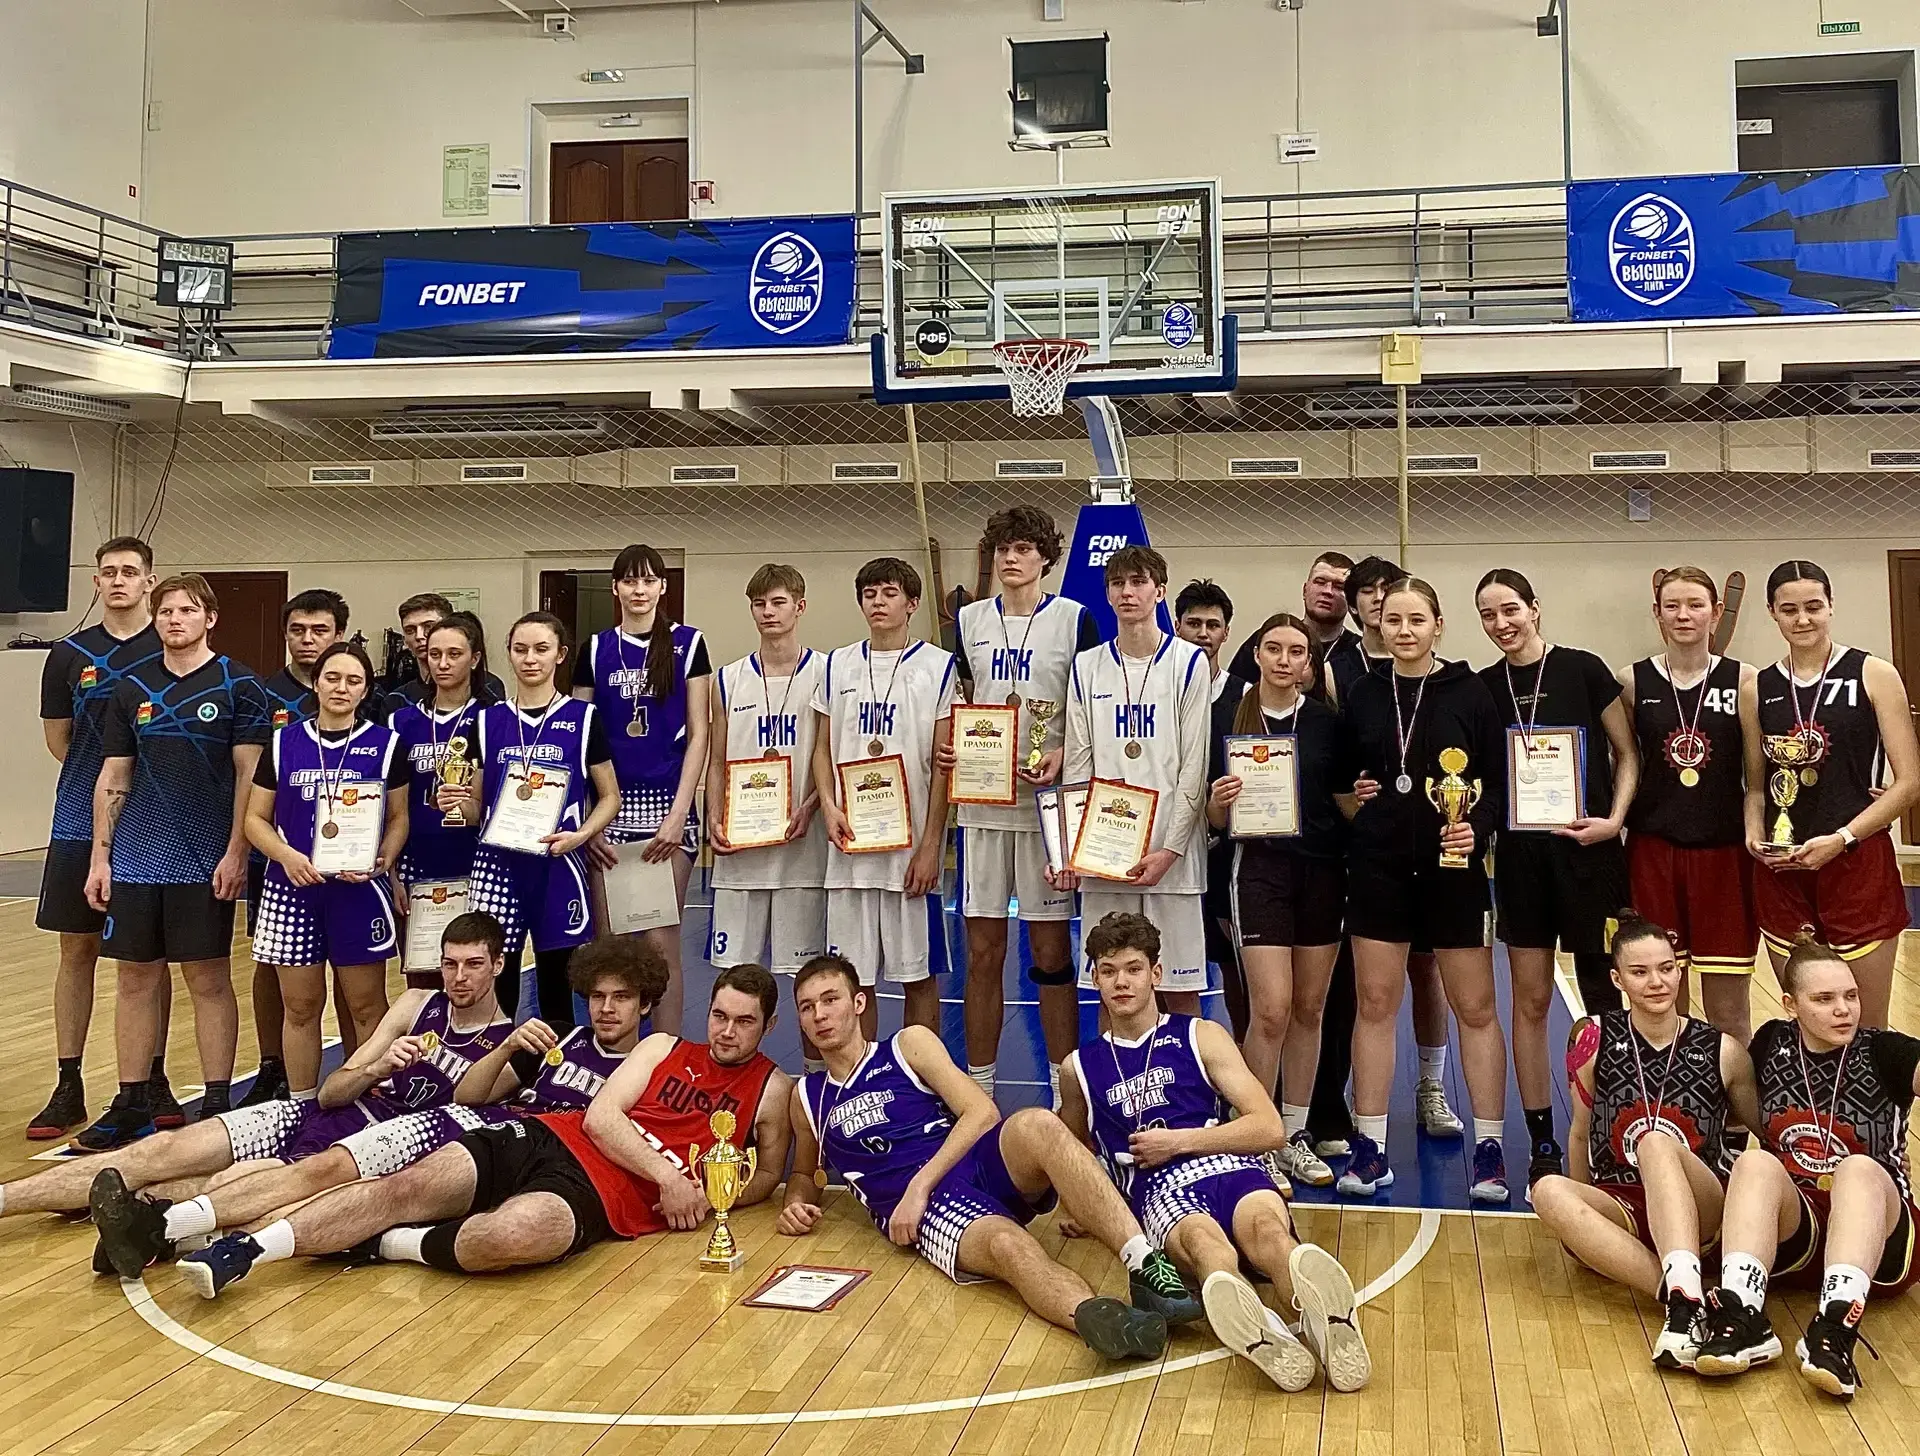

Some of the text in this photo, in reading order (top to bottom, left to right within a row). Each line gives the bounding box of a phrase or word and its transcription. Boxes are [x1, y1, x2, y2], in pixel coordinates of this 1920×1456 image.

[1823, 23, 1858, 33] ВЫХОД
[1157, 205, 1193, 220] FON
[910, 217, 945, 232] FON
[1157, 221, 1193, 235] BET
[910, 233, 943, 248] BET
[1629, 250, 1676, 260] FONBET
[1621, 263, 1684, 282] ВЫСШАЯ
[418, 282, 526, 306] FONBET
[766, 284, 806, 294] FONBET
[1643, 281, 1664, 291] ЛИГА
[758, 296, 811, 313] ВЫСШАЯ
[774, 312, 792, 321] ЛИГА
[918, 332, 948, 344] РФБ
[1161, 353, 1214, 369] Schelde
[1088, 535, 1128, 551] FON
[1088, 551, 1115, 567] BE
[991, 648, 1034, 681] НПК
[1822, 678, 1858, 707] 71
[738, 703, 757, 712] Larsen
[1703, 687, 1737, 715] 43
[858, 702, 897, 735] НПК
[1115, 703, 1156, 738] НПК
[758, 714, 797, 747] НПК
[963, 741, 1002, 749] ГРАМОТА
[740, 792, 778, 800] ГРАМОТА
[856, 791, 895, 802] ГРАМОТА
[1096, 816, 1137, 831] ГРАМОТА
[567, 899, 583, 926] 2
[371, 918, 387, 943] 3
[421, 1043, 473, 1085] АТК
[1687, 1052, 1705, 1061] РФБ
[551, 1060, 607, 1099] ОАТ
[843, 1106, 888, 1137] ОАТК
